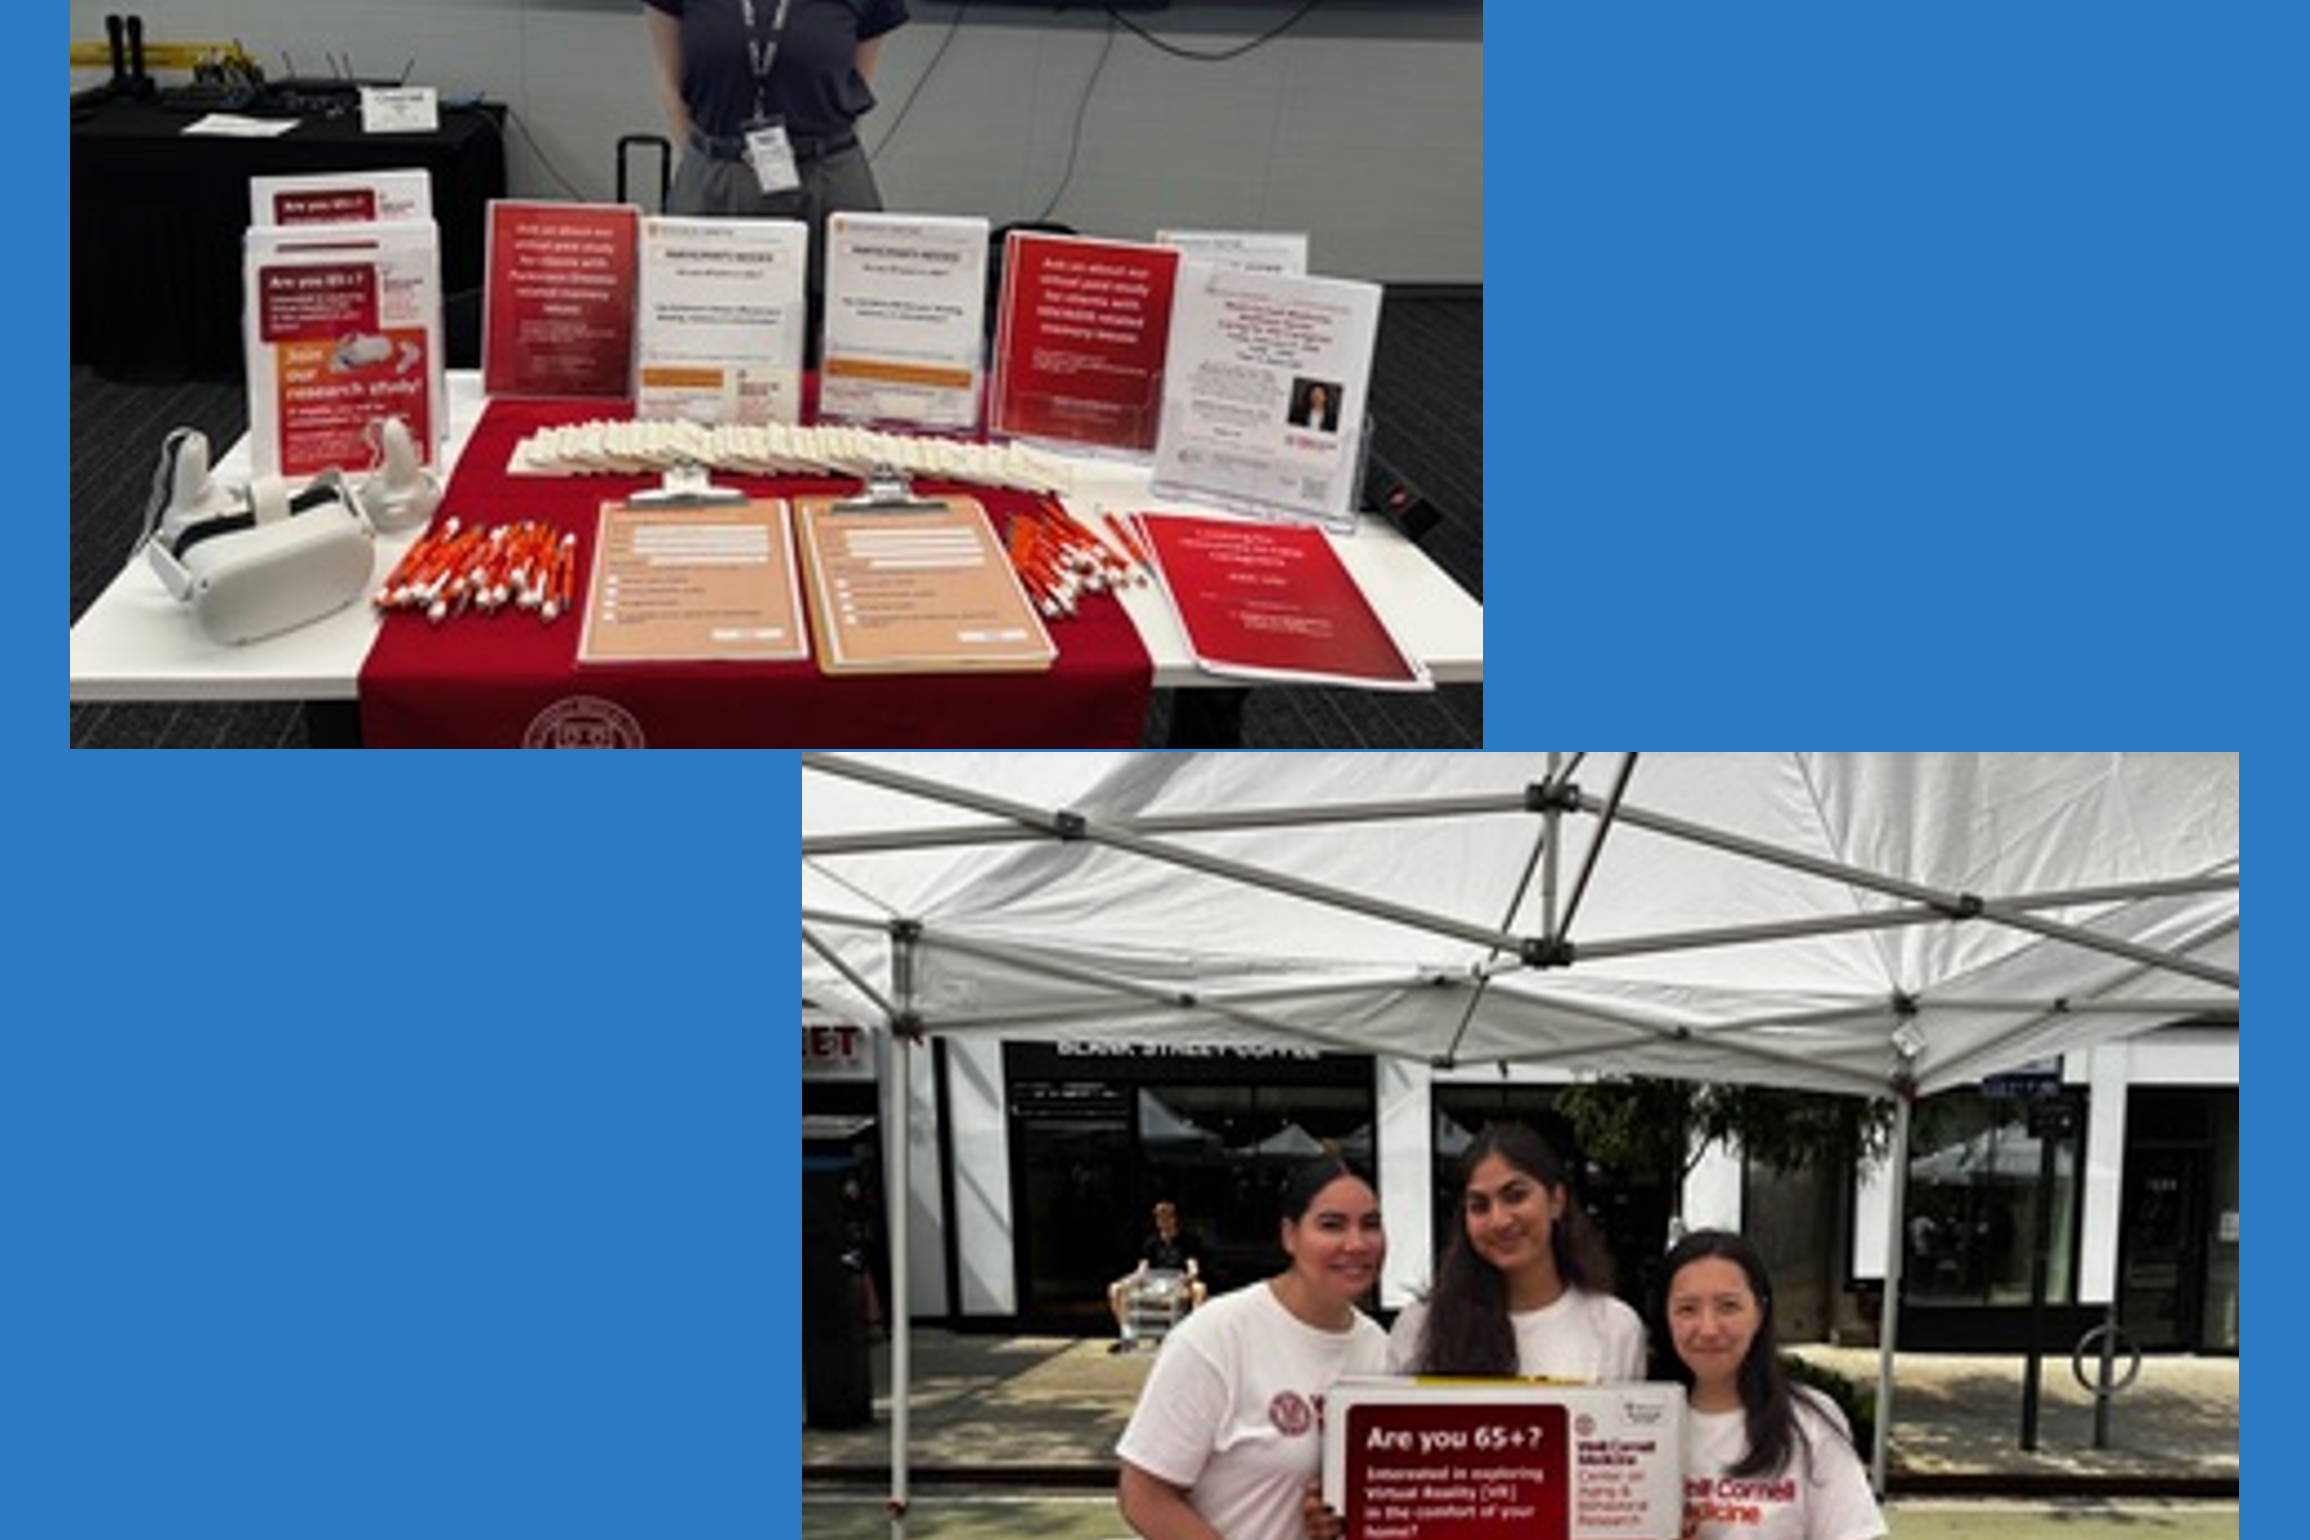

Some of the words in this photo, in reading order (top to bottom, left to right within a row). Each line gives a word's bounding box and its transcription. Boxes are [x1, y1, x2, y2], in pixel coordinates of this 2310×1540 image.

[1367, 1427, 1413, 1449] Are
[1419, 1431, 1467, 1455] you
[1474, 1427, 1543, 1450] 65+?
[1367, 1466, 1449, 1480] Interested
[1453, 1467, 1467, 1480] in
[1718, 1478, 1796, 1501] Cornell
[1384, 1506, 1409, 1519] the
